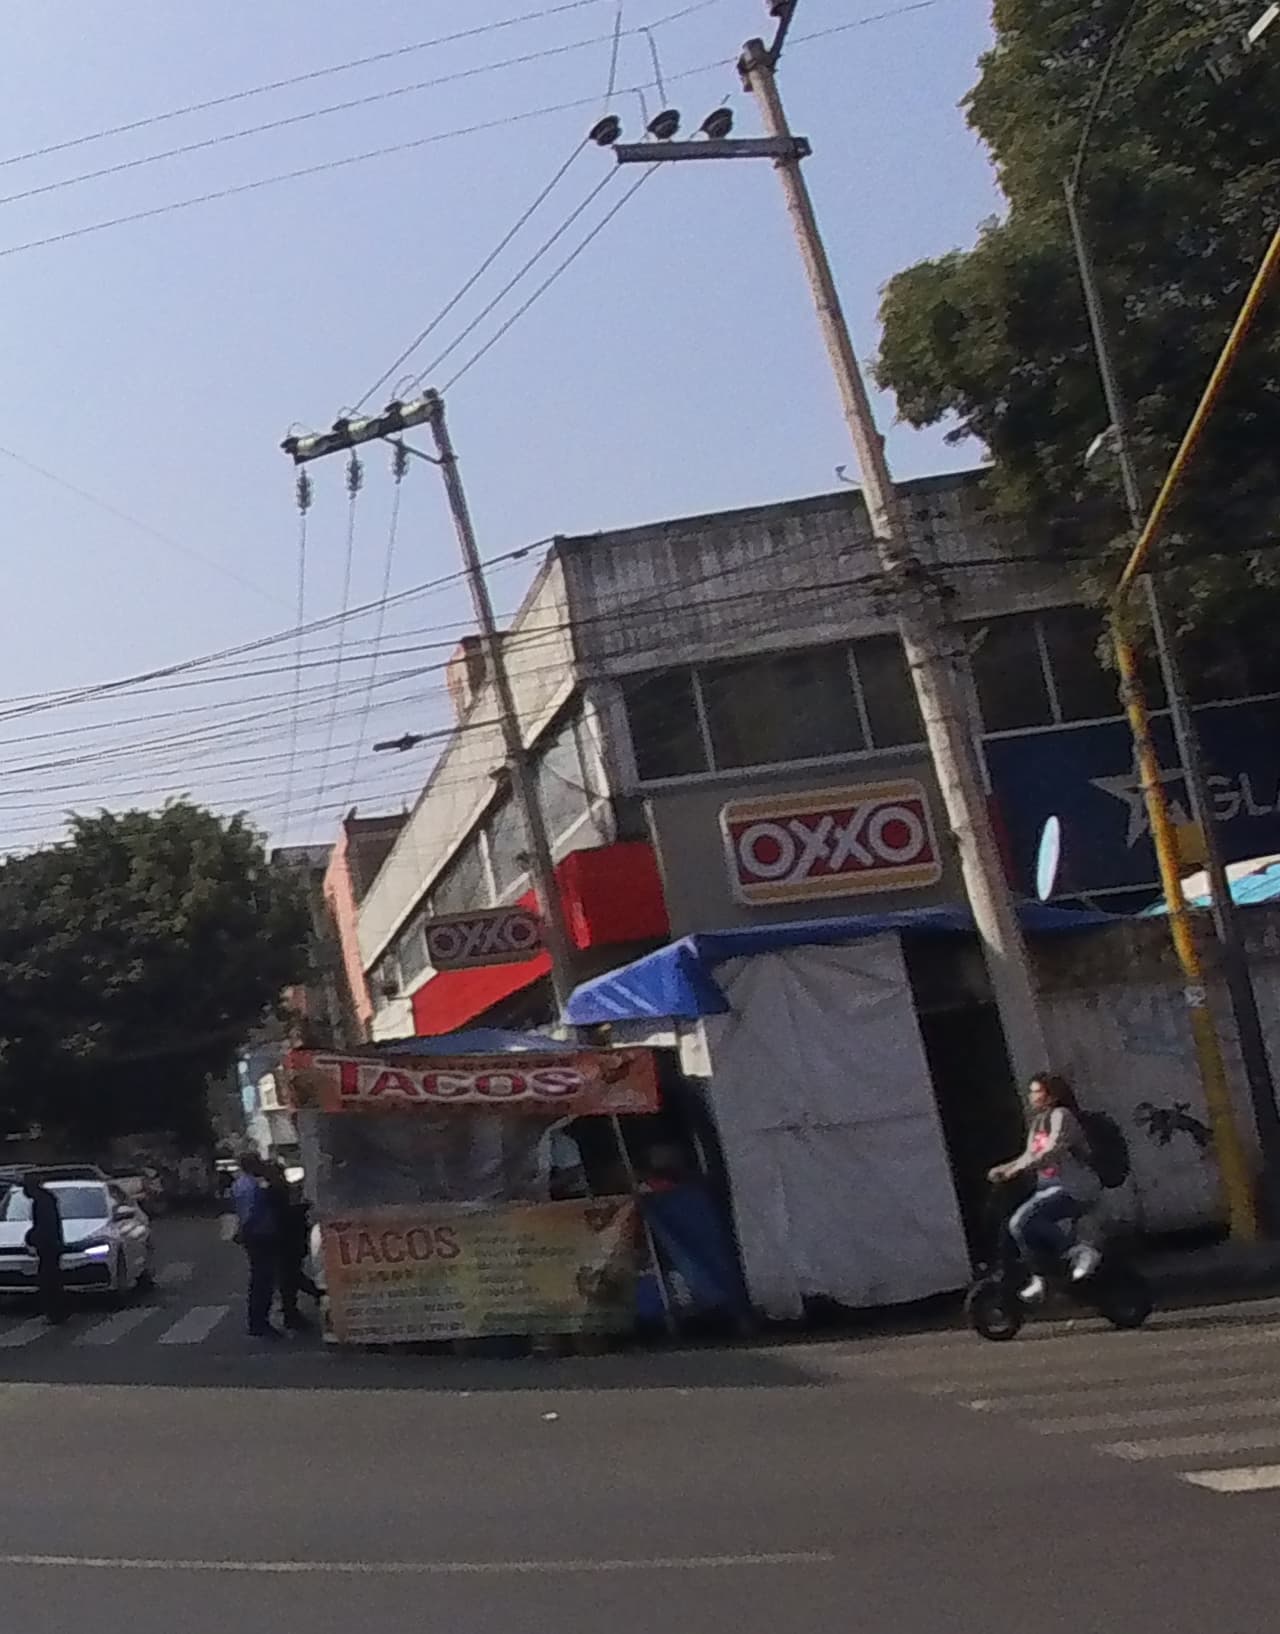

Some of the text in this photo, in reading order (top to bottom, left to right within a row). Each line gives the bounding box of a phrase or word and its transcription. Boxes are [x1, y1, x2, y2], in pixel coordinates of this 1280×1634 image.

[738, 805, 924, 884] OXXO
[429, 916, 537, 960] OXXO
[312, 1055, 583, 1100] TACOS
[329, 1220, 461, 1266] TACOS
